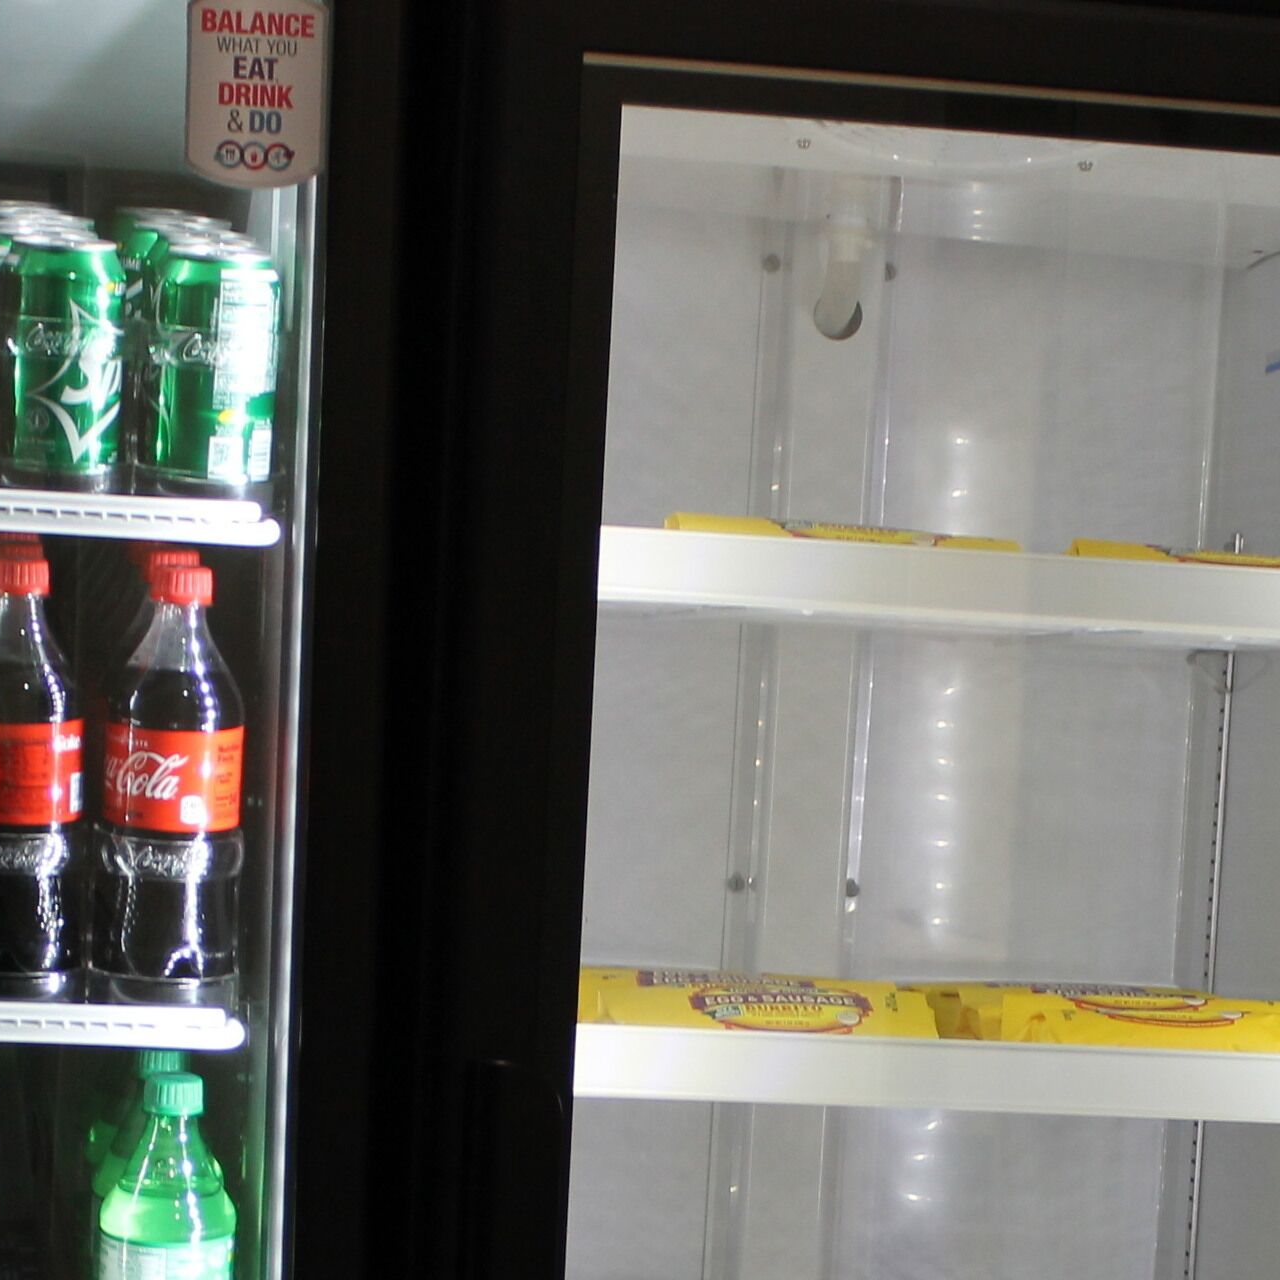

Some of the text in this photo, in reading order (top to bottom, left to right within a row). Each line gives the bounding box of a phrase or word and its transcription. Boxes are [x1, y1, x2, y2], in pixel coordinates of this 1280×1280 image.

[201, 9, 315, 38] BALANCE
[217, 36, 297, 56] WHAT YOU
[218, 82, 293, 110] DRINK
[227, 109, 281, 134] & DO
